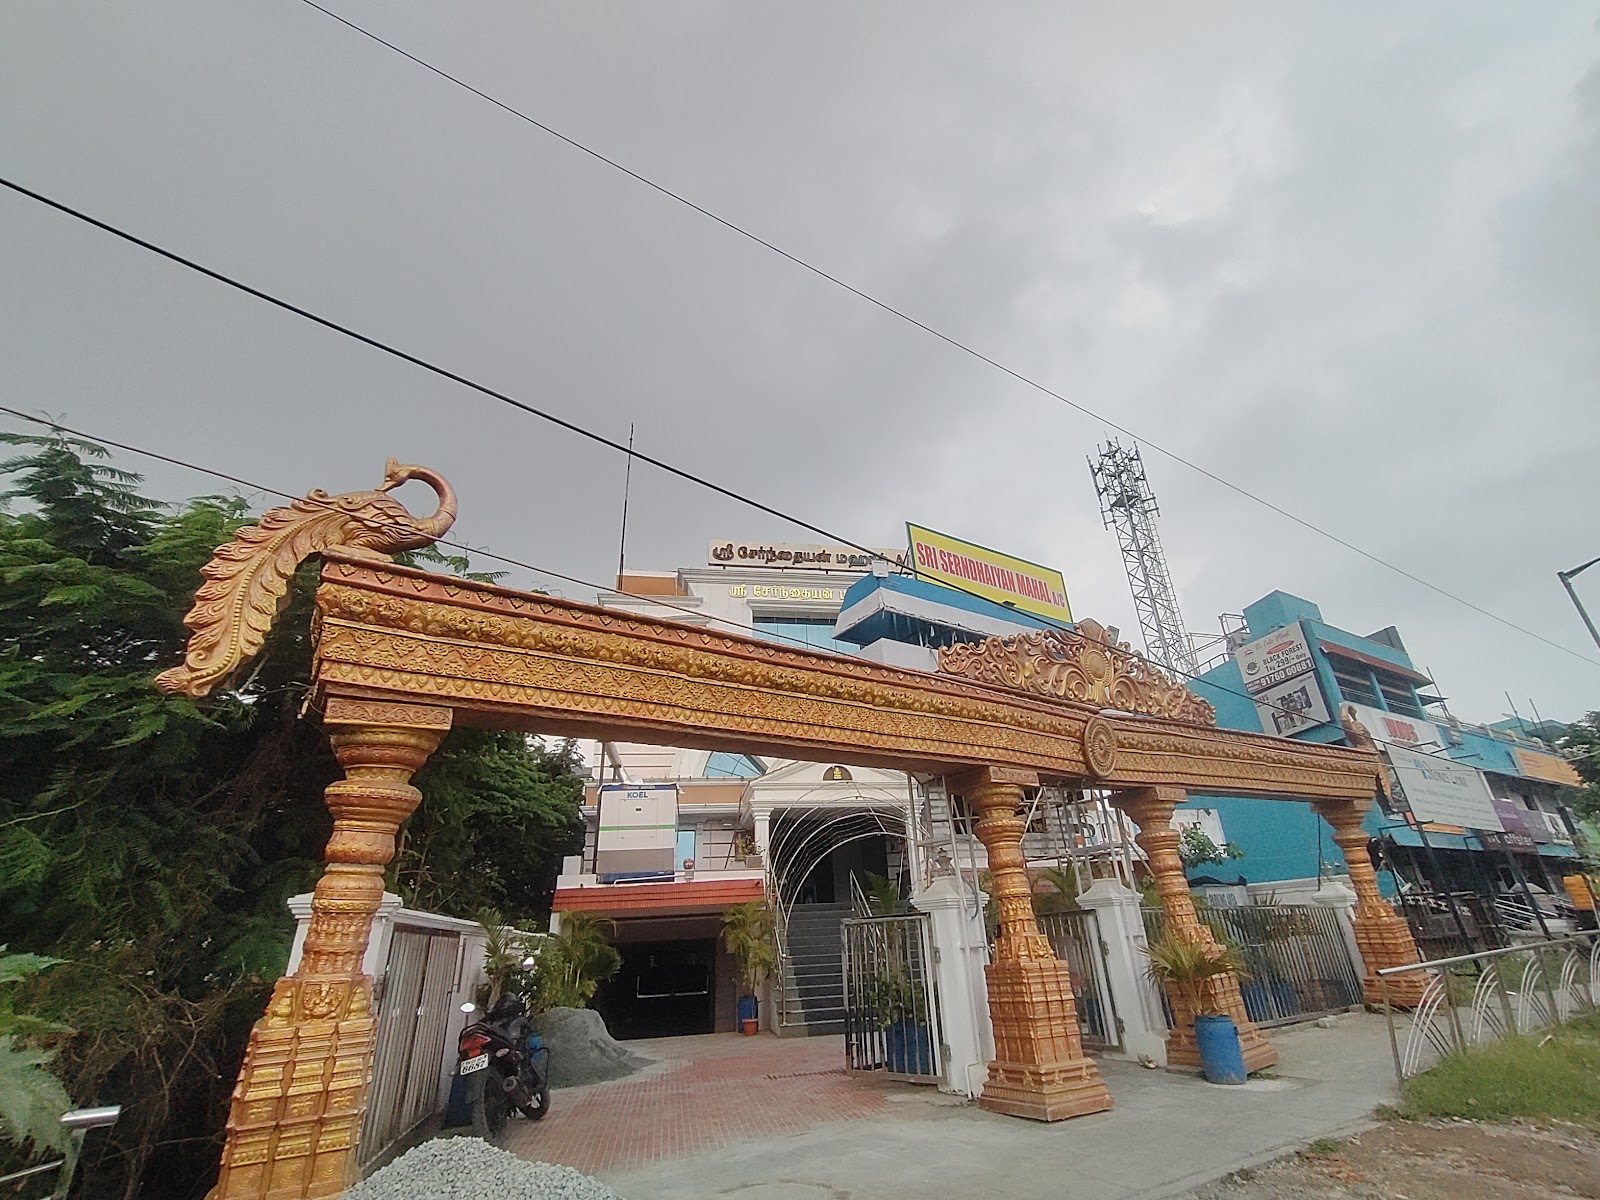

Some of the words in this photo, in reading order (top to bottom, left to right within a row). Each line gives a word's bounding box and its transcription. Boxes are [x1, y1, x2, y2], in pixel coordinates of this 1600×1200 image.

[916, 542, 939, 570] SRI
[939, 549, 1016, 592] SERNDHAIYAN
[1015, 573, 1052, 603] MAHAL
[1051, 591, 1065, 608] A/C
[1262, 652, 1282, 665] BLACK
[1281, 643, 1303, 659] FOREST
[1260, 670, 1286, 687] 91760
[1286, 658, 1313, 676] 00881
[627, 791, 648, 799] KOEL
